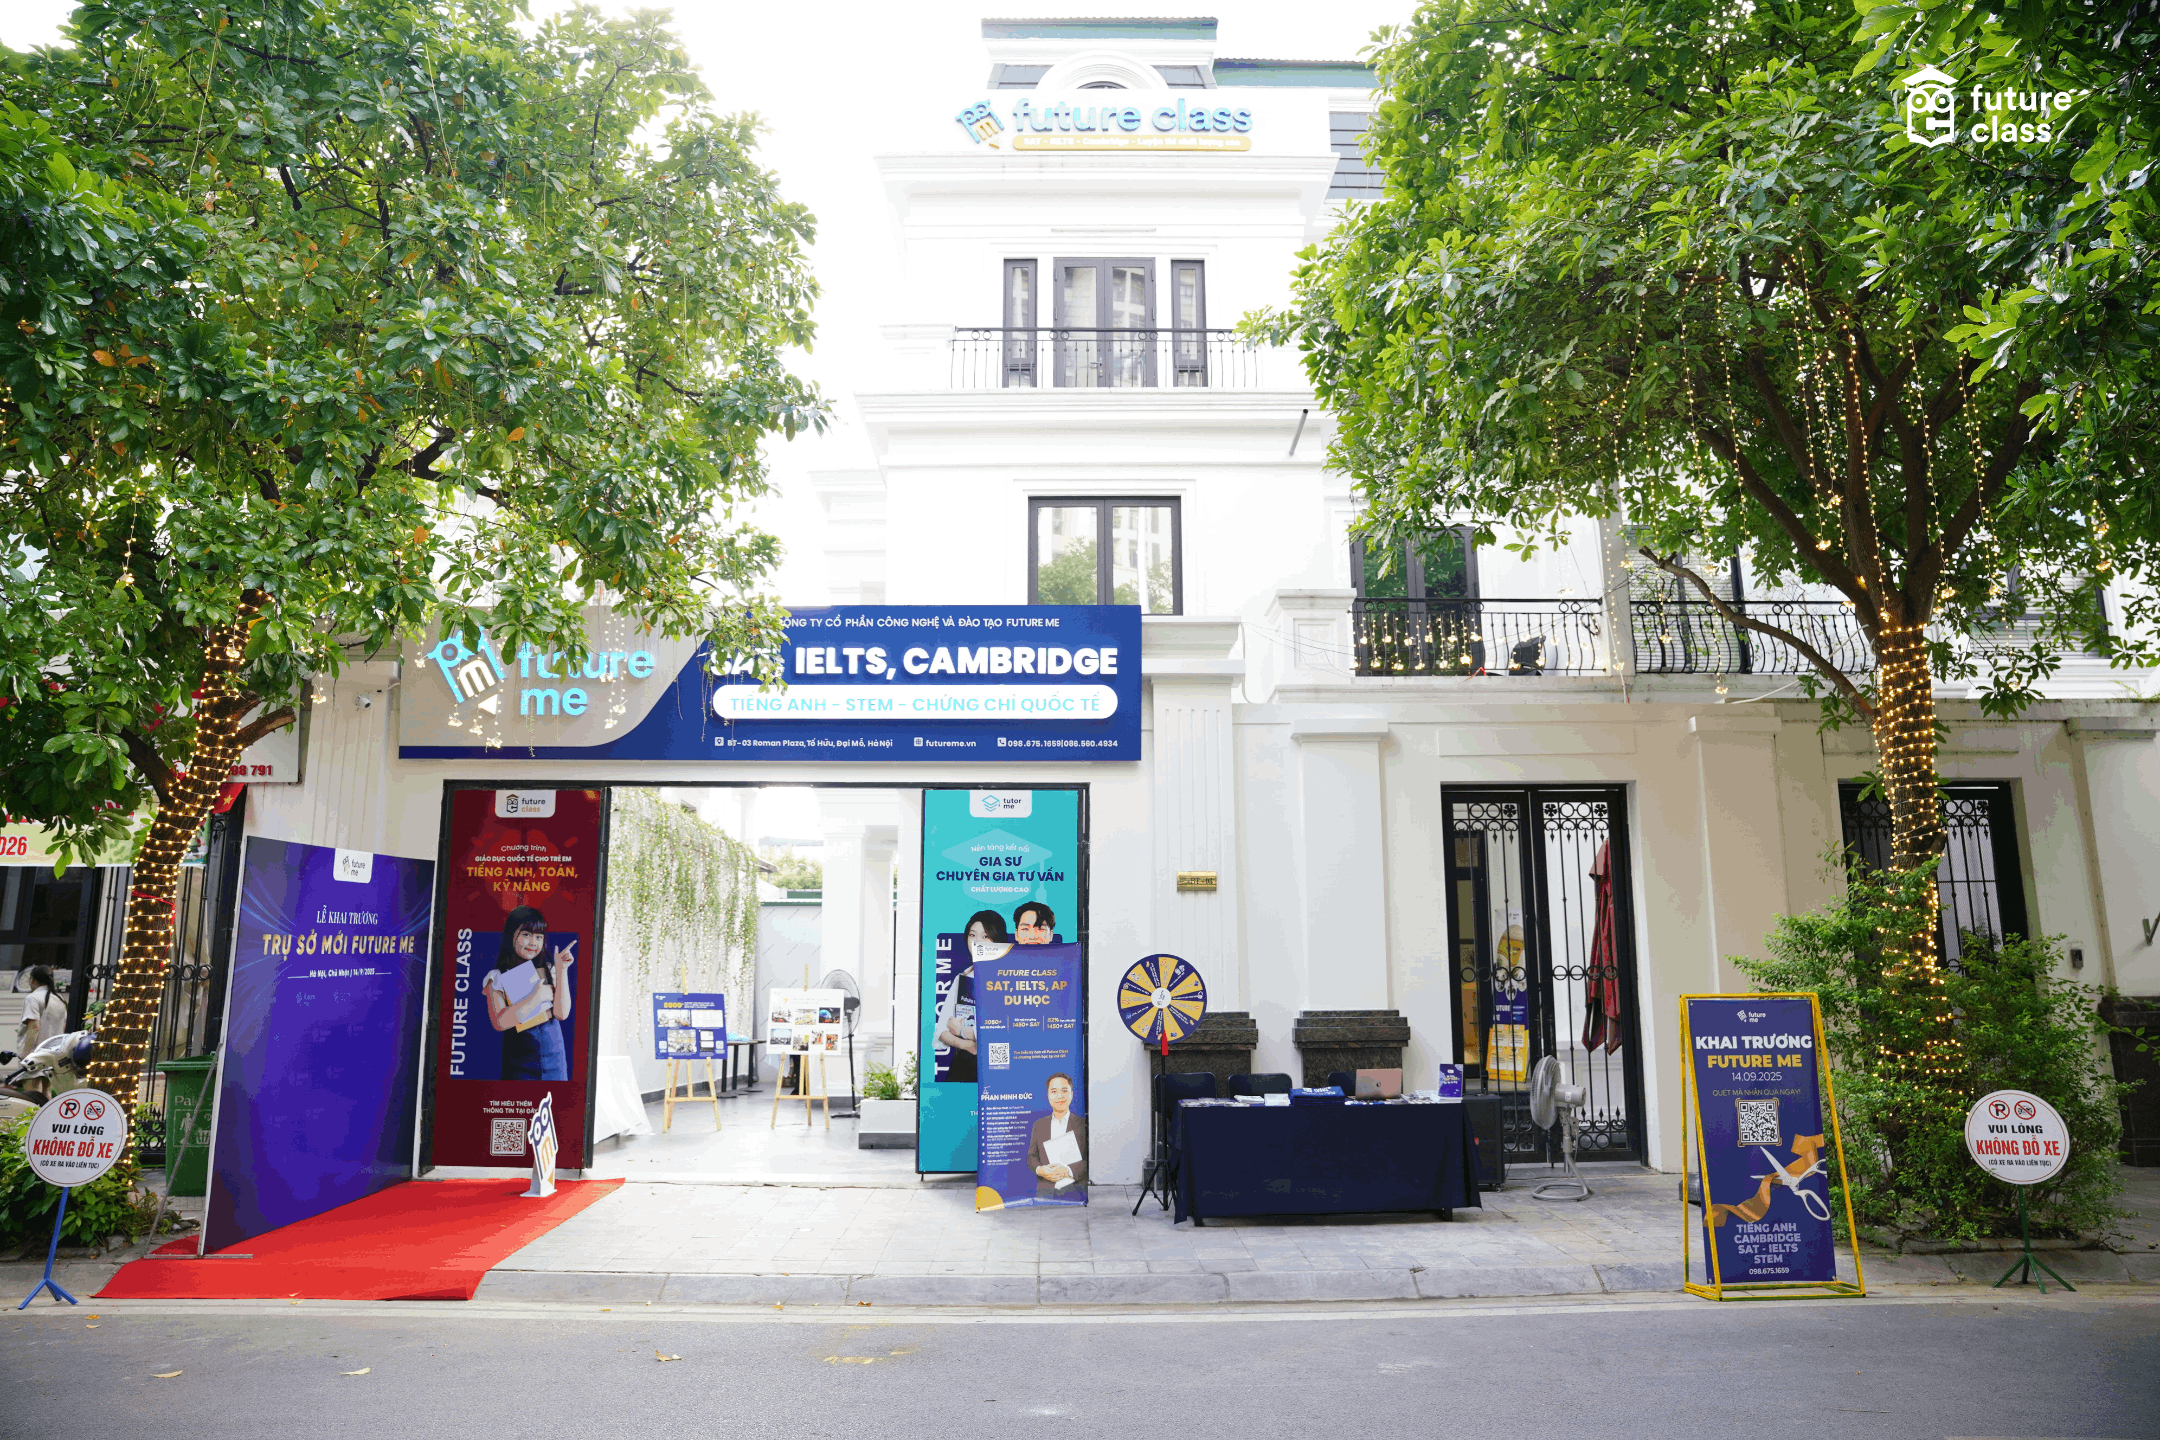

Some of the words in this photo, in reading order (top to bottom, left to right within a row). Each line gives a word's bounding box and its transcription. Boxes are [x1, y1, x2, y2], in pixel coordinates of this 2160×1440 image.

[1013, 98, 1141, 132] future
[1152, 98, 1252, 132] class
[1024, 138, 1041, 147] SAT
[810, 619, 822, 627] TY
[825, 614, 842, 627] CỔ
[845, 614, 873, 627] PHẦN
[877, 616, 908, 627] CÔNG
[912, 616, 939, 629] NGHỆ
[942, 617, 955, 627] VÀ
[958, 617, 980, 627] ĐÀO
[983, 618, 1002, 629] TẠO
[1006, 618, 1043, 627] FUTURE
[1045, 618, 1060, 627] ME
[517, 641, 655, 678] fuure
[795, 647, 896, 680] IELTS,
[903, 646, 1118, 675] CAMBRIDGE
[520, 686, 589, 716] me
[730, 690, 782, 711] TIẾNG
[788, 698, 826, 711] ANH
[846, 698, 893, 711] STEM
[912, 693, 979, 711] CHỨNG
[984, 694, 1015, 711] CHỈ
[1020, 691, 1075, 713] QUỐC
[1082, 691, 1100, 711] TẾ
[752, 739, 781, 747] Roman
[783, 739, 806, 748] Plaza,
[836, 739, 850, 748] Đại
[867, 738, 879, 747] Hà
[879, 738, 893, 748] Nội
[926, 738, 976, 747] futureme.vn
[250, 765, 271, 776] 791
[521, 805, 540, 813] class
[475, 854, 491, 862] GIÁO
[507, 854, 525, 862] QUỐC
[979, 857, 1002, 866] GIA
[1005, 855, 1022, 866] SƯ
[351, 860, 365, 869] future
[467, 862, 503, 877] TIẾNG
[506, 867, 536, 878] ANH,
[539, 864, 578, 878] TOÁN,
[936, 868, 990, 881] CHUYÊN
[992, 871, 1015, 881] GIA
[1018, 871, 1035, 881] TƯ
[1037, 867, 1064, 881] VẤN
[513, 879, 550, 891] NĂNG
[317, 905, 327, 923] LỄ
[329, 911, 347, 923] KHAI
[349, 911, 378, 925] TRƯƠNG
[263, 934, 291, 961] TRỤ
[296, 929, 317, 955] SỞ
[321, 930, 348, 954] MỚI
[351, 936, 396, 954] FUTURE
[399, 936, 415, 953] ME
[454, 928, 472, 992] CLASS
[936, 938, 952, 974] ME
[309, 970, 316, 978] Hà
[986, 981, 1013, 992] SAT,
[1016, 981, 1049, 992] IELTS,
[1051, 981, 1067, 990] AP
[1004, 995, 1021, 1005] DU
[1023, 995, 1050, 1007] HỌC
[450, 997, 469, 1076] FUTURE
[1695, 1036, 1737, 1049] KHAI
[1741, 1033, 1812, 1049] TRƯƠNG
[1707, 1055, 1772, 1068] FUTURE
[1777, 1054, 1802, 1067] ME
[1732, 1072, 1782, 1081] 14.09.2025
[1018, 1092, 1033, 1100] ĐỨC
[52, 1124, 70, 1133] VUI
[73, 1123, 104, 1135] LÒNG
[1988, 1125, 2008, 1133] VUI
[2012, 1123, 2043, 1134] LÒNG
[32, 1137, 75, 1156] KHÔNG
[77, 1136, 95, 1157] ĐỖ
[96, 1143, 114, 1158] XE
[1976, 1137, 2020, 1155] KHÔNG
[2023, 1135, 2040, 1156] ĐỖ
[2045, 1141, 2060, 1156] XE
[1736, 1221, 1770, 1233] TIẾNG
[1772, 1223, 1797, 1232] ANH
[1734, 1233, 1801, 1244] CAMBRIDGE
[1738, 1245, 1760, 1254] SAT
[1769, 1243, 1798, 1253] IELTS
[1754, 1254, 1783, 1264] STEM
[1749, 1267, 1789, 1275] 098.675.1659
